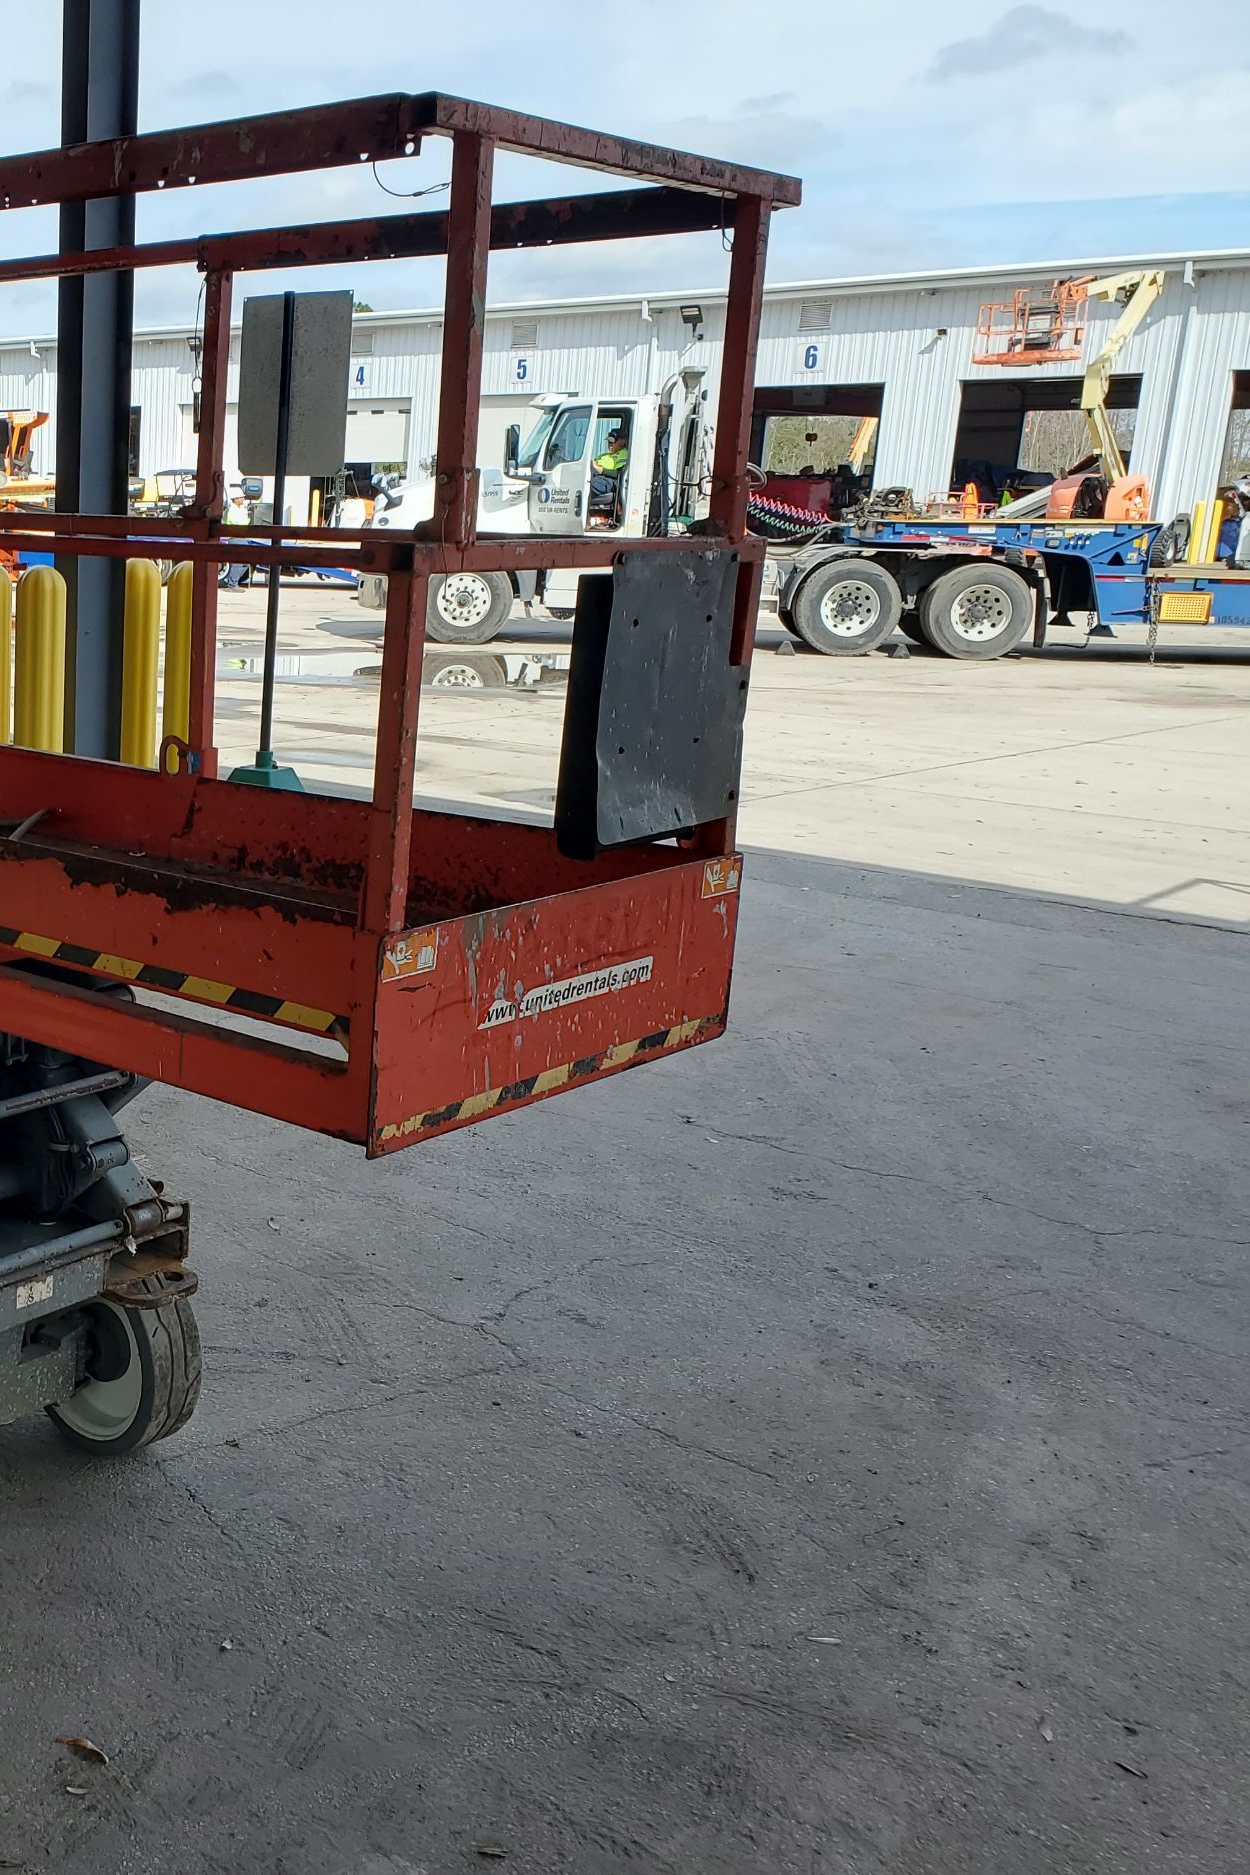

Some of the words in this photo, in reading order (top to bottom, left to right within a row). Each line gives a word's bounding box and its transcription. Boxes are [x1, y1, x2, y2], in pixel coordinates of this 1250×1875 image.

[805, 345, 818, 369] 6
[355, 366, 364, 385] 4
[517, 359, 527, 380] 5
